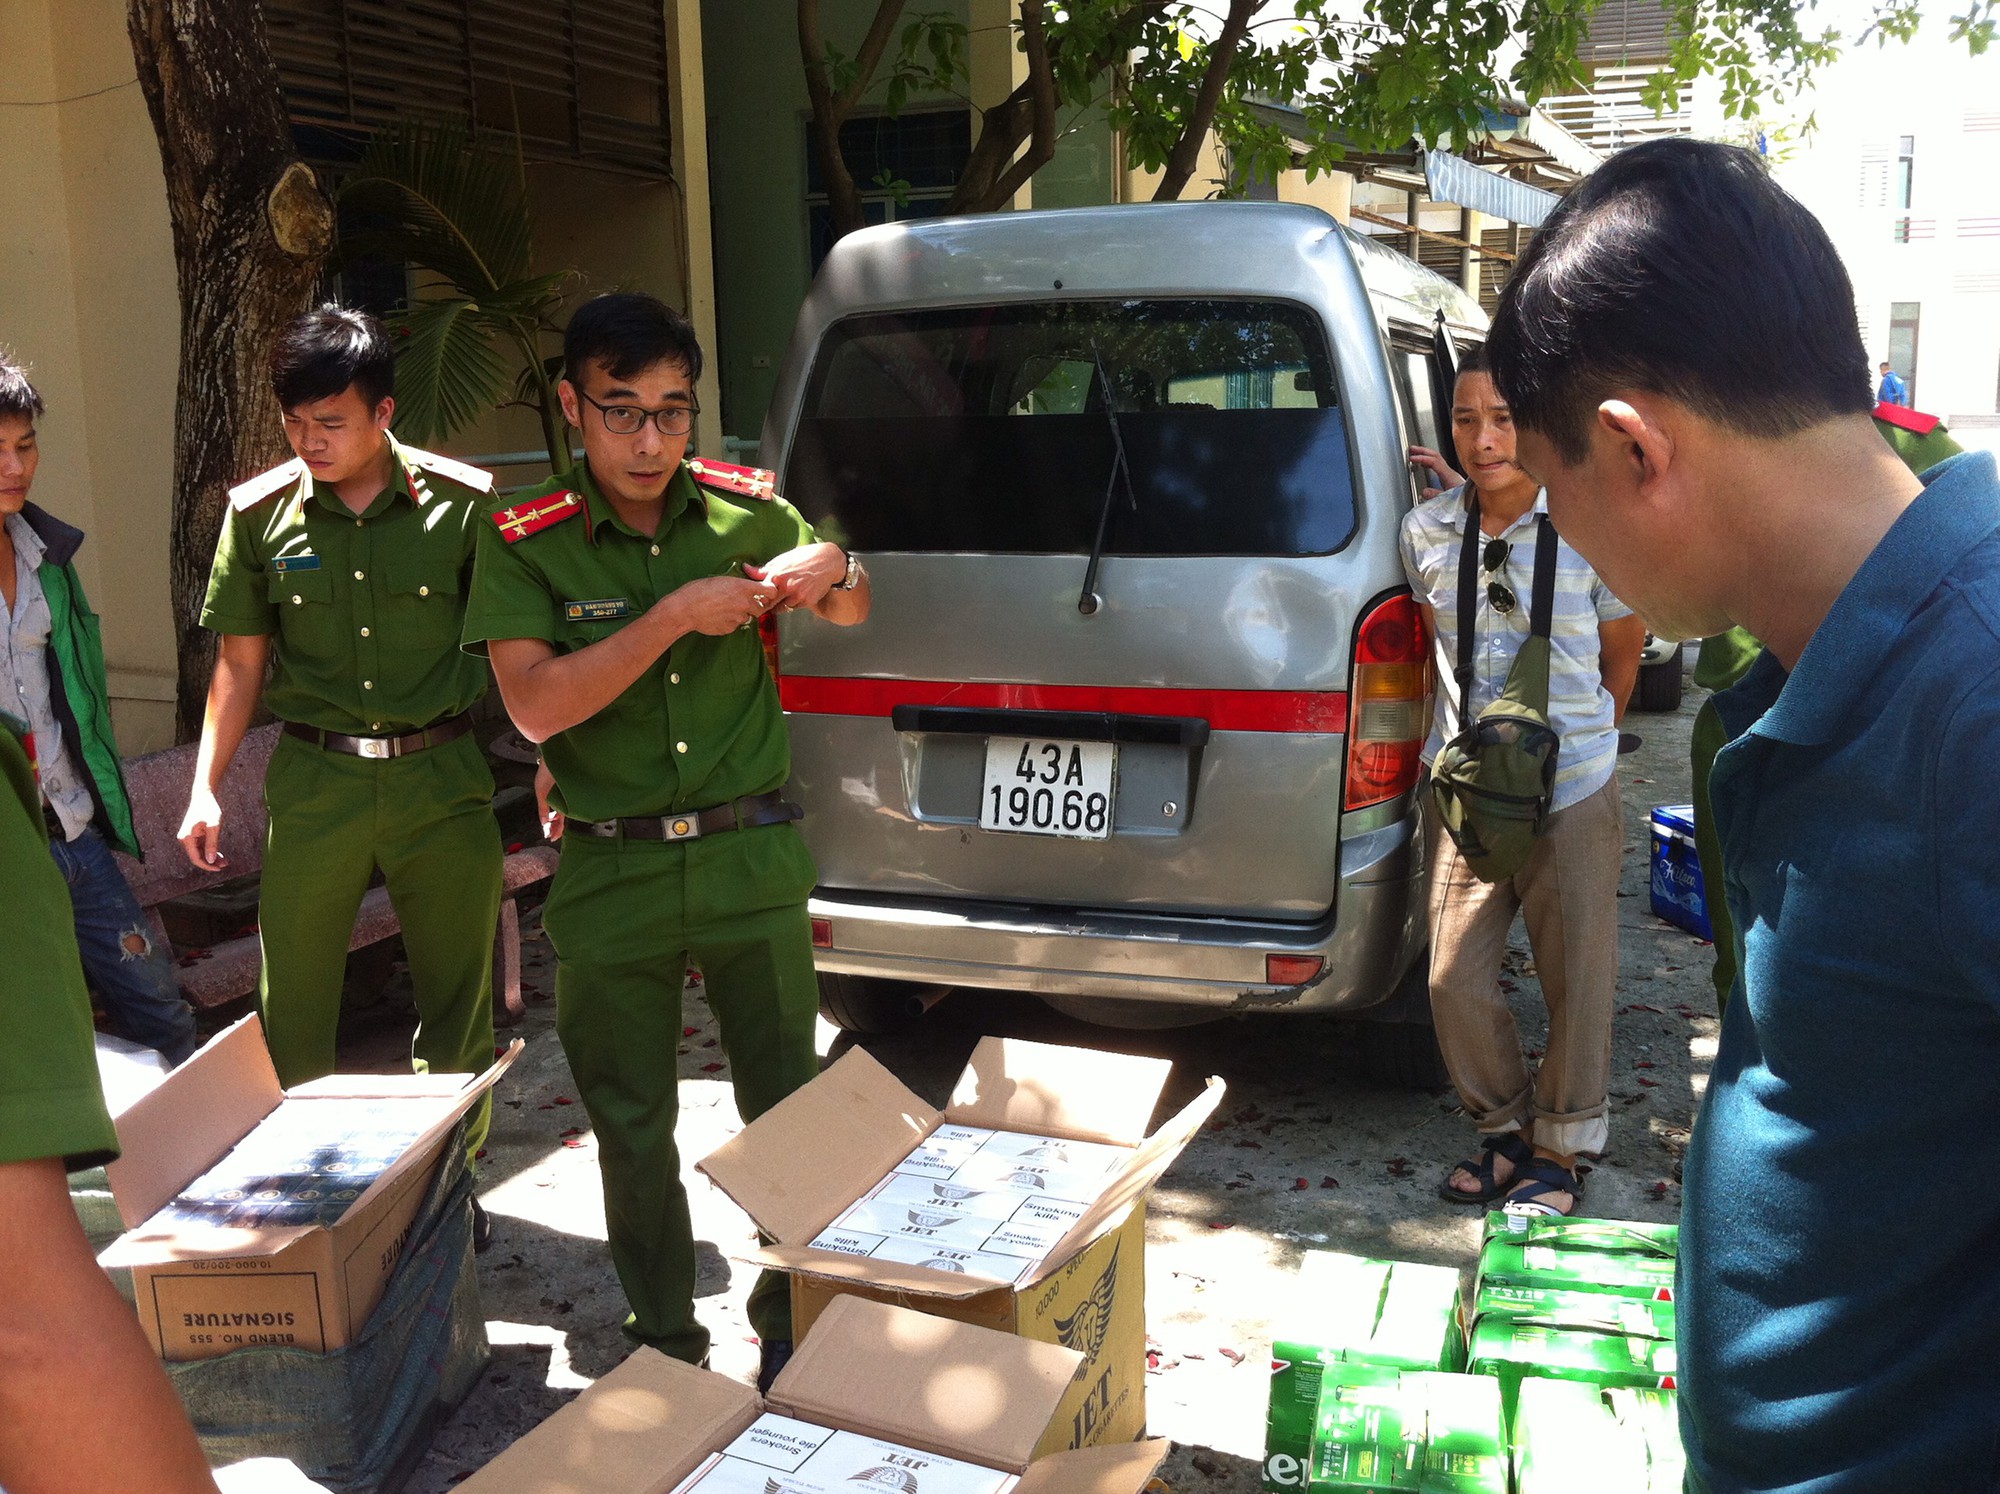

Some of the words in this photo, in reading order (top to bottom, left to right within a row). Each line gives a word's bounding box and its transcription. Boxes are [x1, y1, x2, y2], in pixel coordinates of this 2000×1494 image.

[1016, 741, 1084, 786] 43A
[990, 785, 1107, 833] 190.68
[927, 1198, 963, 1208] JET
[1024, 1203, 1080, 1219] Smoking
[1034, 1211, 1059, 1221] kills
[901, 1226, 938, 1236] JET
[1003, 1231, 1047, 1242] Smoker
[834, 1237, 859, 1246] kills
[811, 1240, 868, 1256] Smoking
[932, 1250, 971, 1261] JET
[183, 1312, 295, 1327] SIGNATURE
[190, 1333, 213, 1344] 555
[218, 1333, 243, 1344] NO.
[248, 1333, 295, 1344] BLEND
[1068, 1363, 1113, 1451] JET
[748, 1427, 799, 1444] younger
[750, 1436, 802, 1455] Smokers
[798, 1441, 817, 1450] die
[881, 1452, 929, 1470] JET
